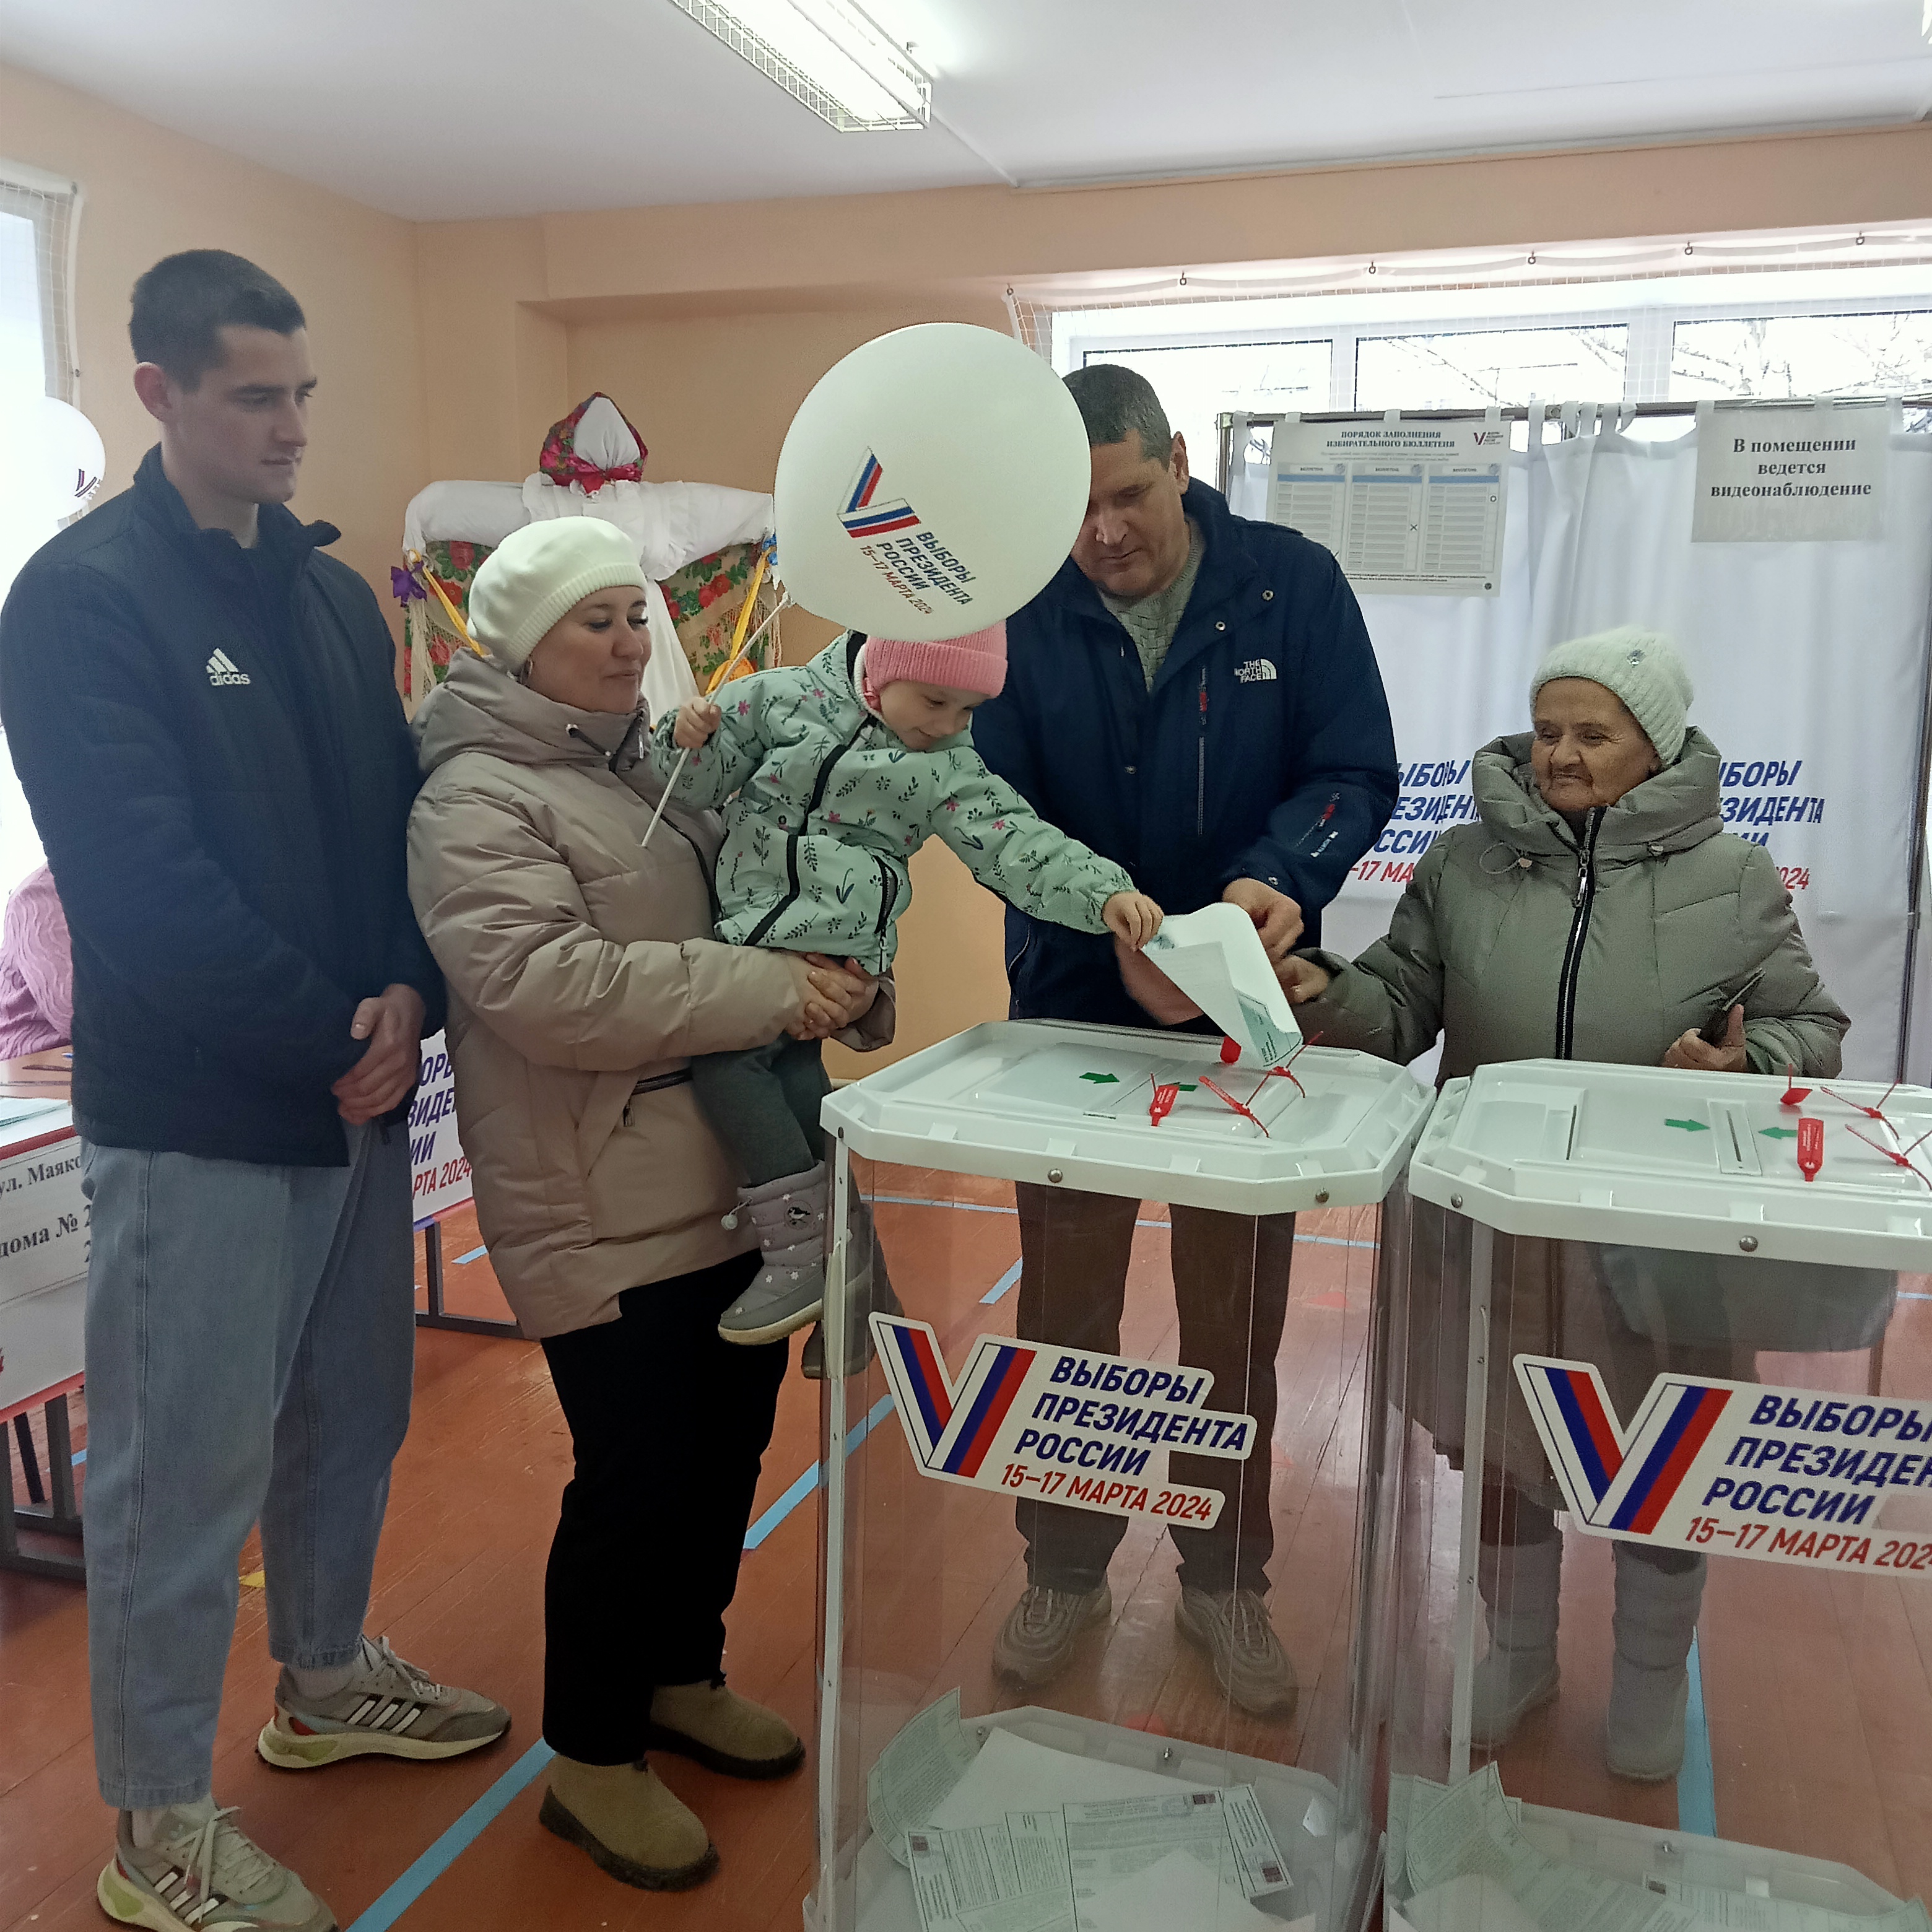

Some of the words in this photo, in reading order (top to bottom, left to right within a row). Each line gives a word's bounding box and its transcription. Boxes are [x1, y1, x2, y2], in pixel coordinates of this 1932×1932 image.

[1733, 438, 1745, 453] В
[1751, 439, 1856, 453] помещении
[1711, 482, 1871, 498] видеонаблюдение
[1758, 463, 1826, 476] ведется
[876, 542, 931, 590] РОССИИ
[895, 537, 973, 605] ПРЕЗИДЕНТА
[916, 531, 977, 583] ВЫБОРЫ
[881, 572, 915, 599] МАРТА
[210, 672, 251, 686] adidas
[1234, 666, 1261, 677] NORTH
[1240, 673, 1261, 684] FACE
[1243, 659, 1260, 669] THE
[412, 1167, 437, 1200] РТА
[439, 1156, 471, 1188] 2024
[1050, 1356, 1204, 1404] ВЫБОРЫ
[1032, 1392, 1248, 1451] ПРЕЗИДЕНТА
[1014, 1428, 1151, 1476] РОССИИ
[1724, 1435, 1932, 1489] ПРЕЗИДЕН
[1066, 1476, 1149, 1511] МАРТА
[1151, 1491, 1212, 1521] 2024
[1702, 1476, 1877, 1525] РОССИИ
[1767, 1527, 1871, 1564] МАРТА
[1873, 1540, 1932, 1570] 202
